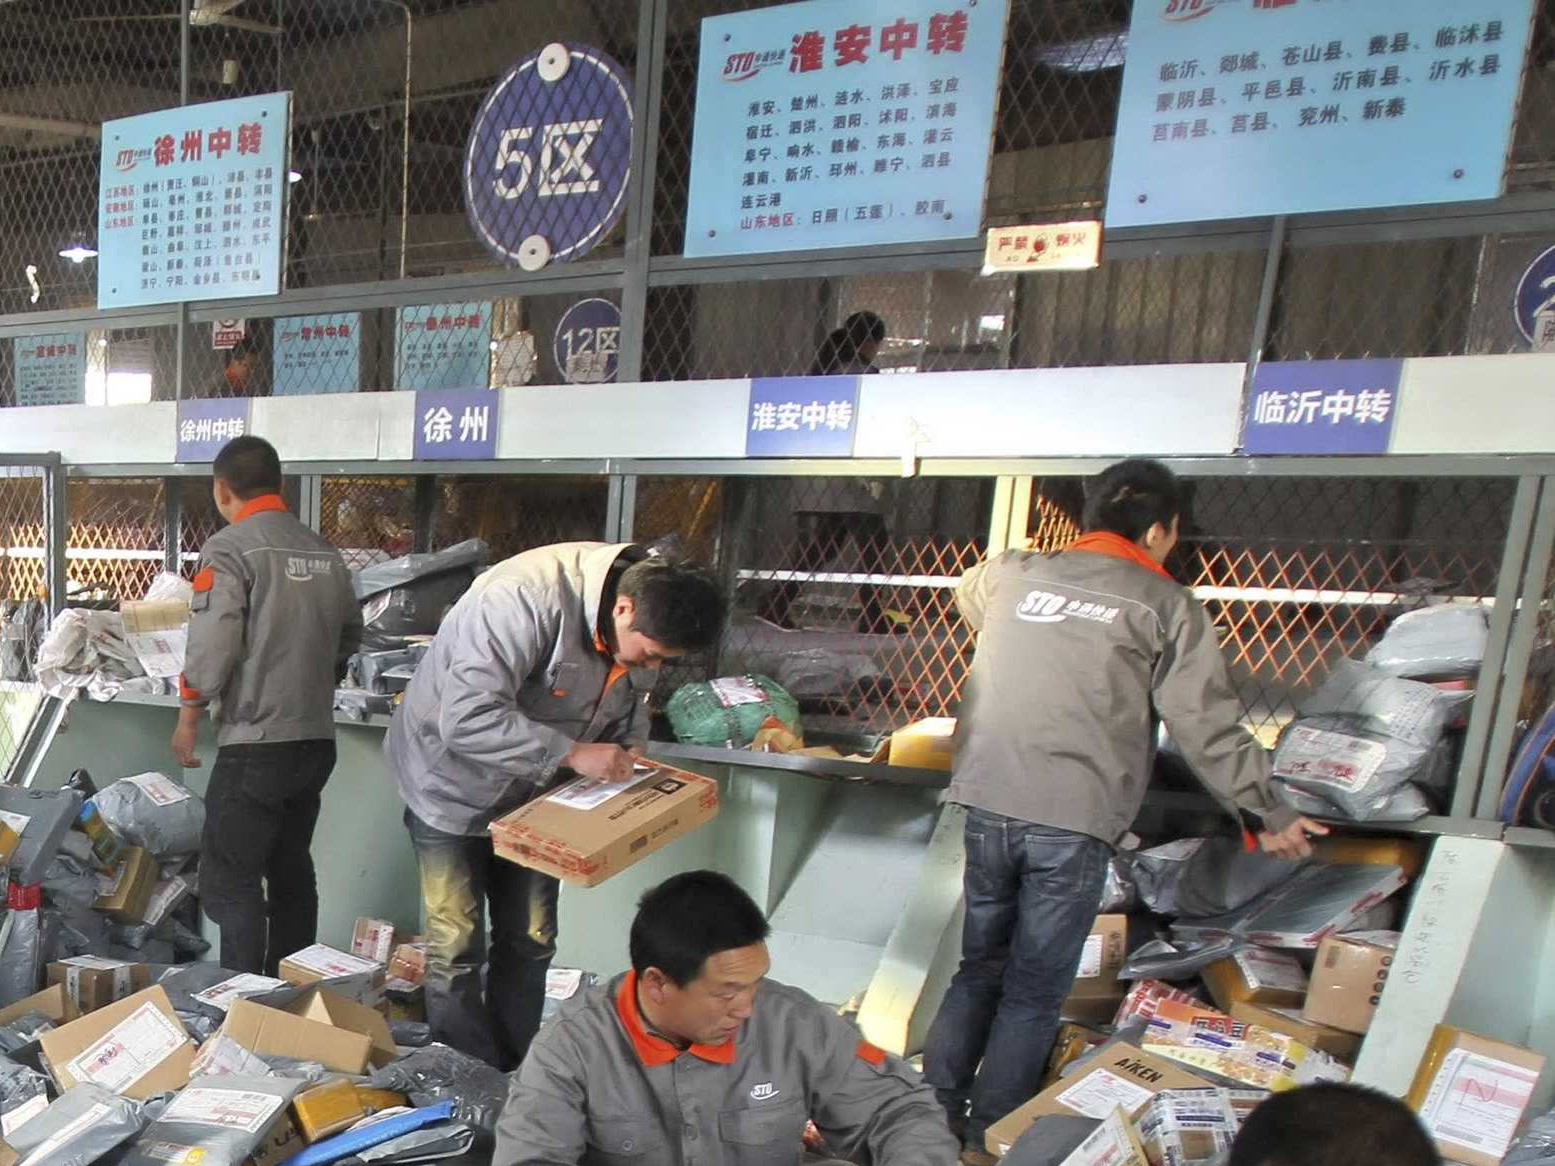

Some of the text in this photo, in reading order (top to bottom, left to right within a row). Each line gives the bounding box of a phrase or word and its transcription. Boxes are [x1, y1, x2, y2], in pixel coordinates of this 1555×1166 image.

[789, 10, 968, 73] 淮安中转
[723, 52, 755, 74] STO
[154, 122, 263, 167] 徐州中转
[493, 119, 603, 200] 5区
[740, 193, 782, 210] 连云港
[562, 326, 621, 361] 12区
[753, 398, 852, 432] 淮安中转
[1255, 388, 1392, 426] 临沂中转
[179, 416, 245, 443] 徐州中转
[423, 405, 489, 444] 徐州
[287, 557, 307, 575] STO
[1020, 590, 1067, 616] STO
[754, 1082, 773, 1096] STO
